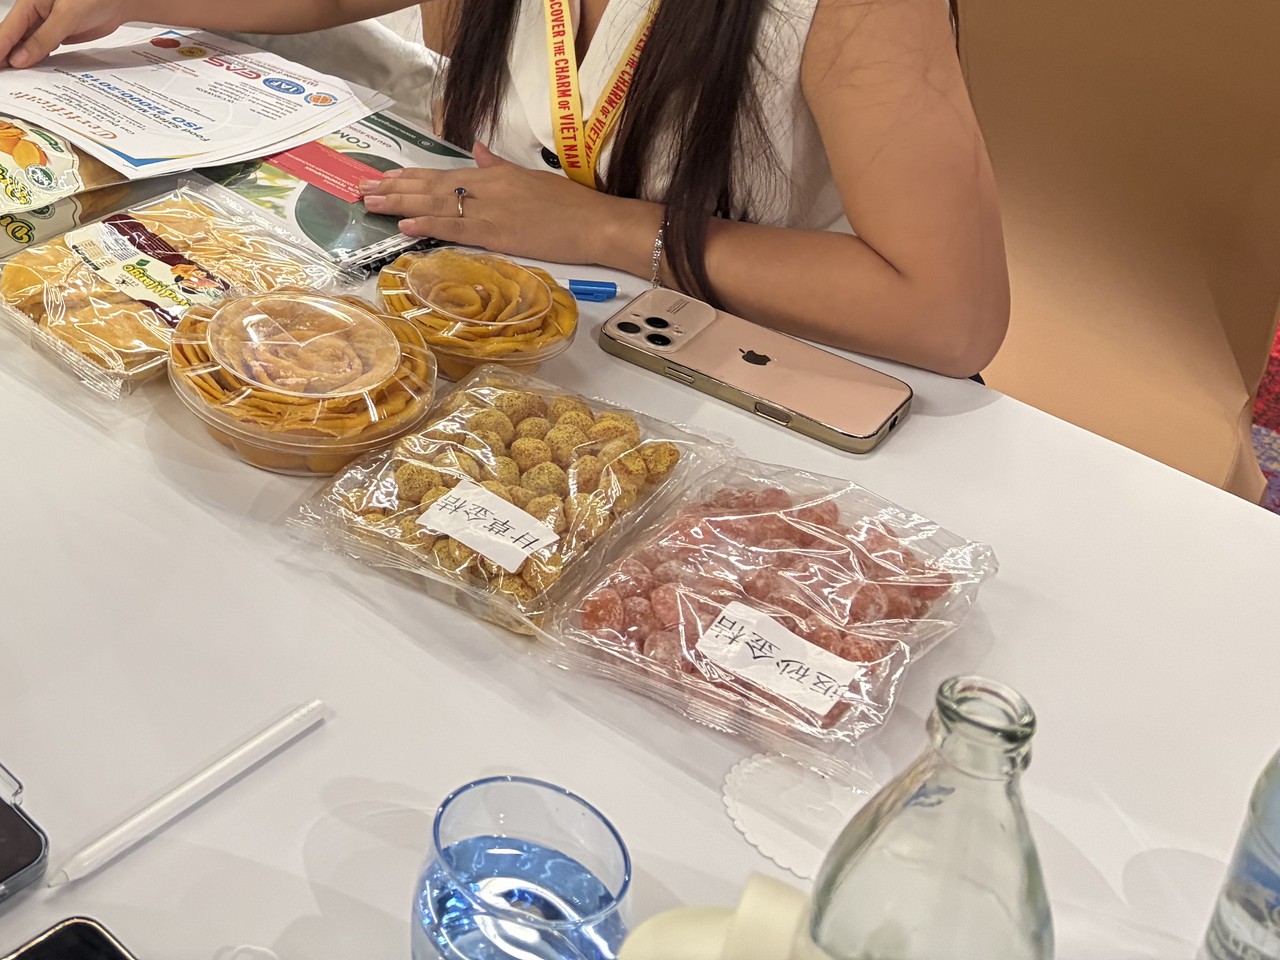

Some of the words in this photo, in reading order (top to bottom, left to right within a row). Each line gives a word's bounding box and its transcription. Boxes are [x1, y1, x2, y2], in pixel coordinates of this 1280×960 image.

[552, 39, 566, 56] THE
[268, 78, 297, 93] IAF
[551, 58, 573, 99] CHARM
[604, 68, 635, 109] CHARM
[80, 70, 170, 117] 22000:2018
[87, 81, 149, 114] Management
[557, 99, 570, 111] OF
[9, 84, 118, 144] Certificate
[149, 111, 182, 129] Safety
[171, 113, 203, 133] ISO
[598, 106, 610, 118] OF
[181, 126, 210, 143] Food
[556, 113, 579, 143] VIỆT
[563, 143, 581, 170] NAM
[119, 260, 167, 295] Mango
[434, 488, 541, 555] 甘草金桔
